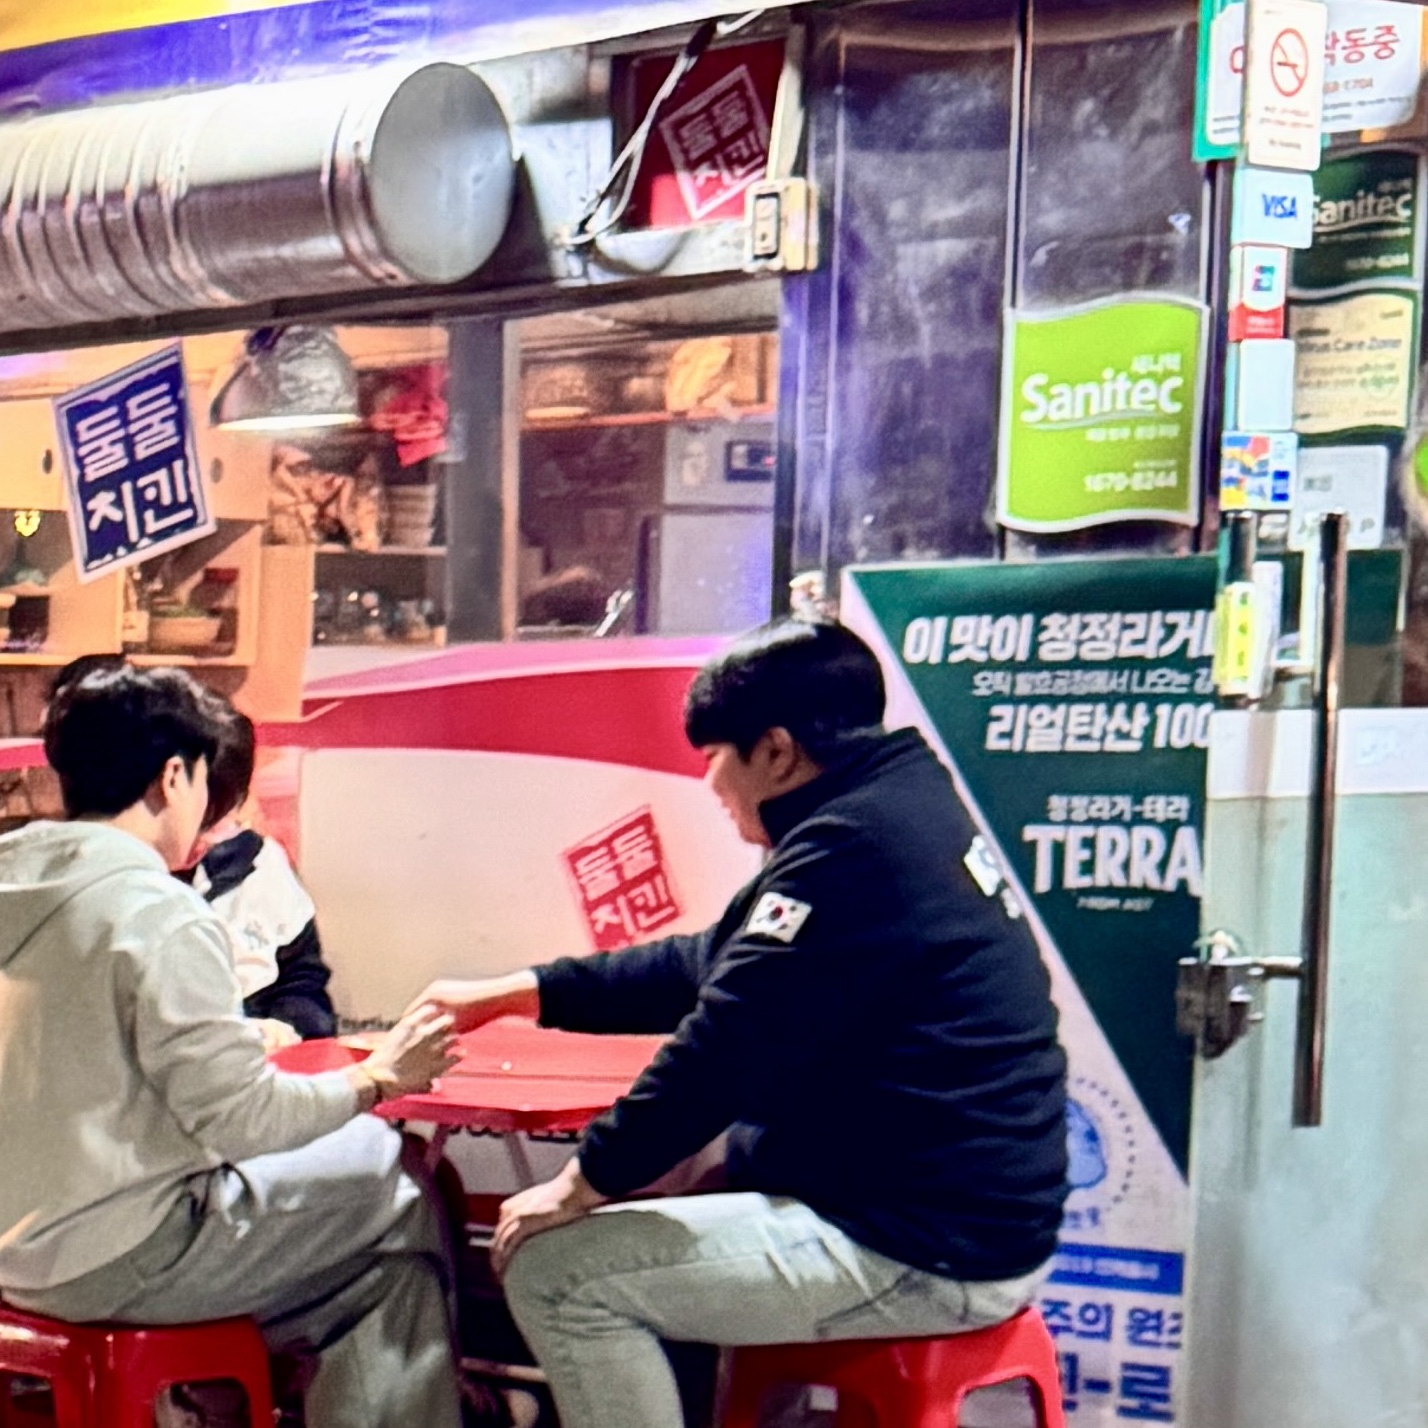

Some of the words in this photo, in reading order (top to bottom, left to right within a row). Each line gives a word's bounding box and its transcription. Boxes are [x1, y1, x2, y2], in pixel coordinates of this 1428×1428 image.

[677, 90, 749, 161] 둘둘
[1261, 193, 1299, 219] VISA
[1020, 366, 1184, 423] Sanitec
[75, 382, 181, 484] 둘둘
[86, 458, 195, 545] 치킨
[903, 616, 947, 664] 이
[948, 613, 1035, 663] 맛이
[985, 702, 1150, 753] 리얼탄산
[575, 825, 659, 902] 둘둘
[1022, 824, 1203, 897] TERRA
[591, 874, 677, 938] 치킨
